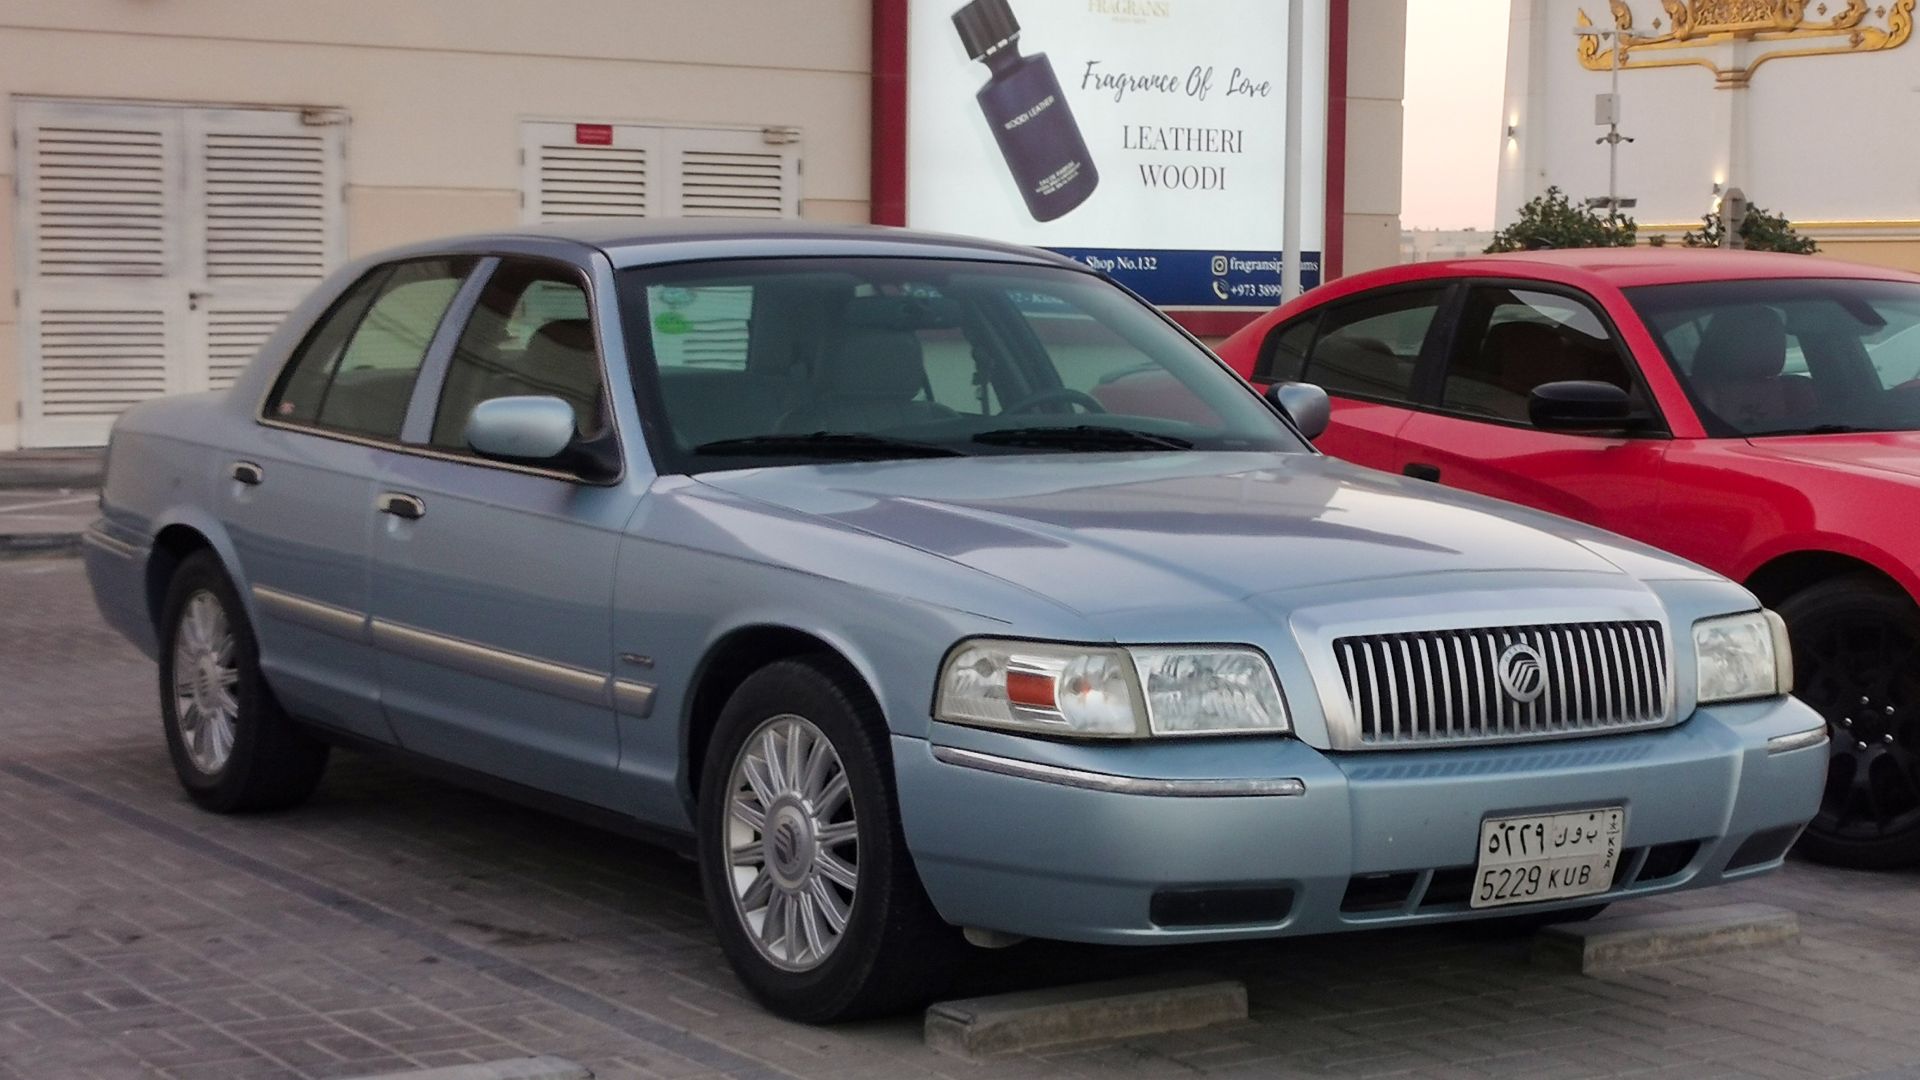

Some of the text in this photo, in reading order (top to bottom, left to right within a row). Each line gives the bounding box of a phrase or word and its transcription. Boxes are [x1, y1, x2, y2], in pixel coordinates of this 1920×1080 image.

[1081, 60, 1271, 102] Fragrance Of Love
[1122, 125, 1243, 153] LEATHERI
[1138, 164, 1227, 190] WOODI
[1086, 256, 1115, 273] Shop
[1231, 284, 1256, 297] +973
[1488, 823, 1544, 857] ٥٢٢٩
[1480, 865, 1592, 901] 5229 KUB
